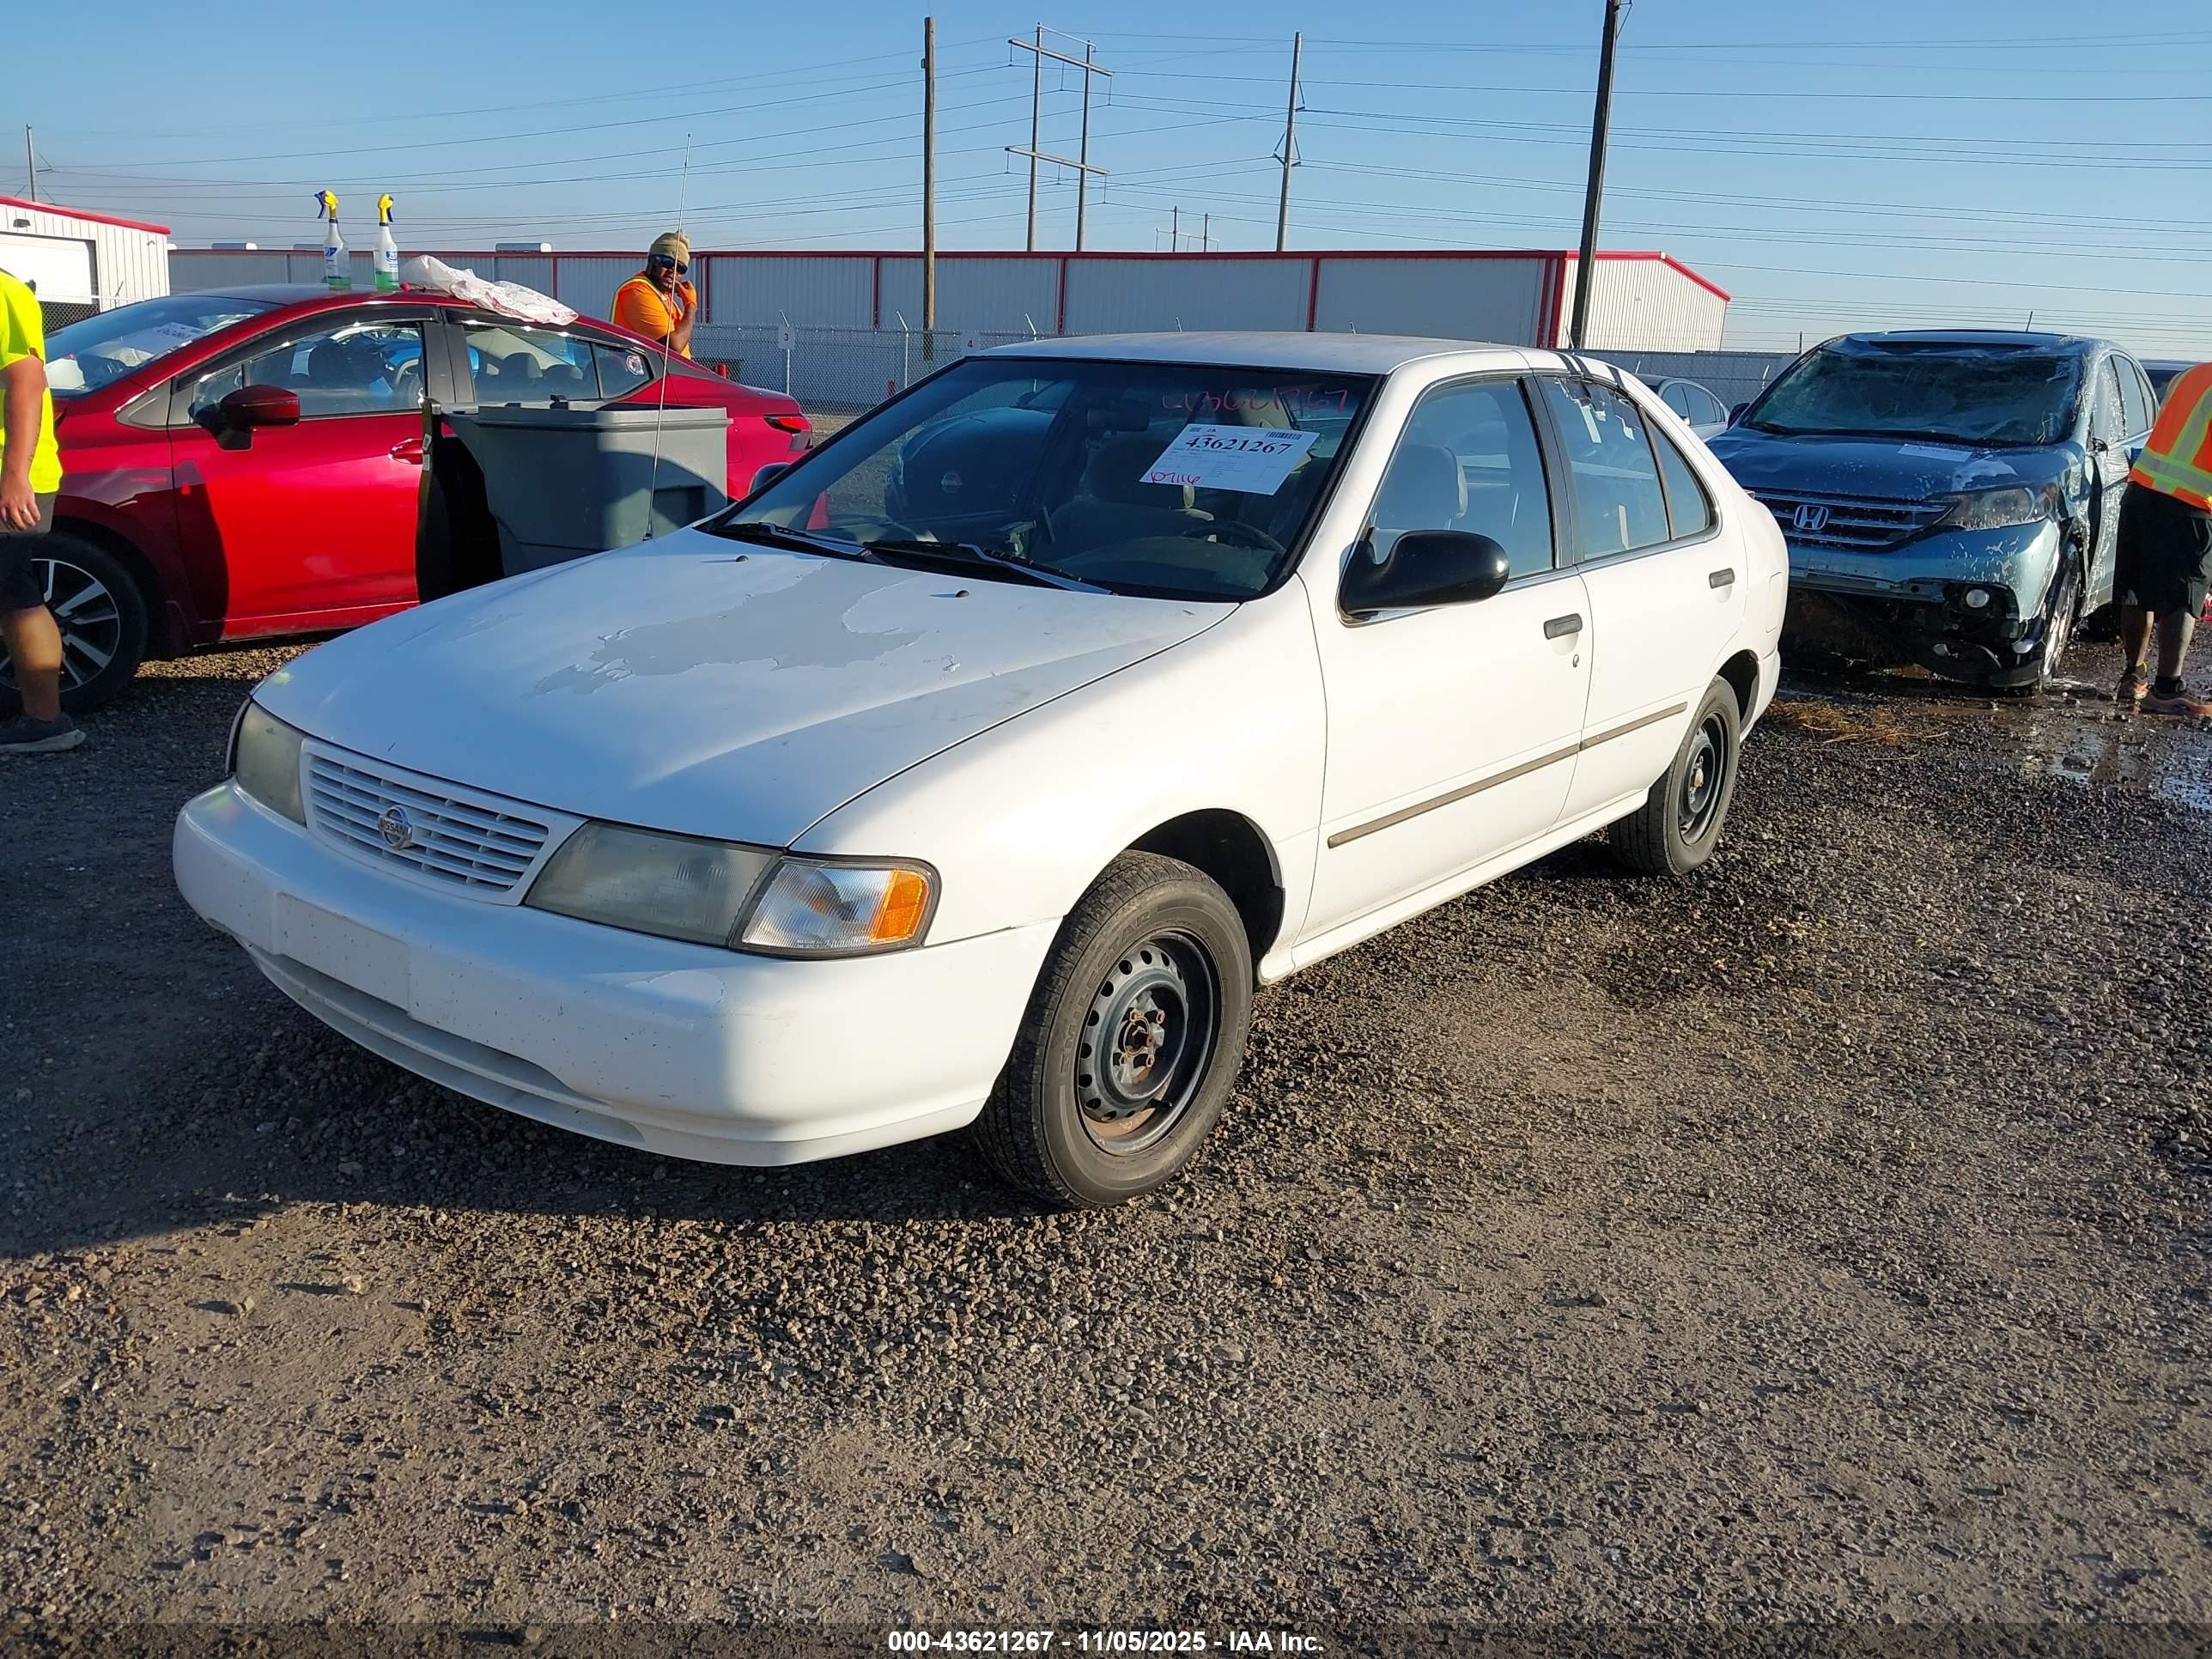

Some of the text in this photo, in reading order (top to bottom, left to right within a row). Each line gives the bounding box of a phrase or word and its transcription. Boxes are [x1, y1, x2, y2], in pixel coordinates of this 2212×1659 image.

[967, 339, 973, 348] 4
[1186, 436, 1291, 454] 43621267
[1061, 910, 1151, 1049] MILESTAR
